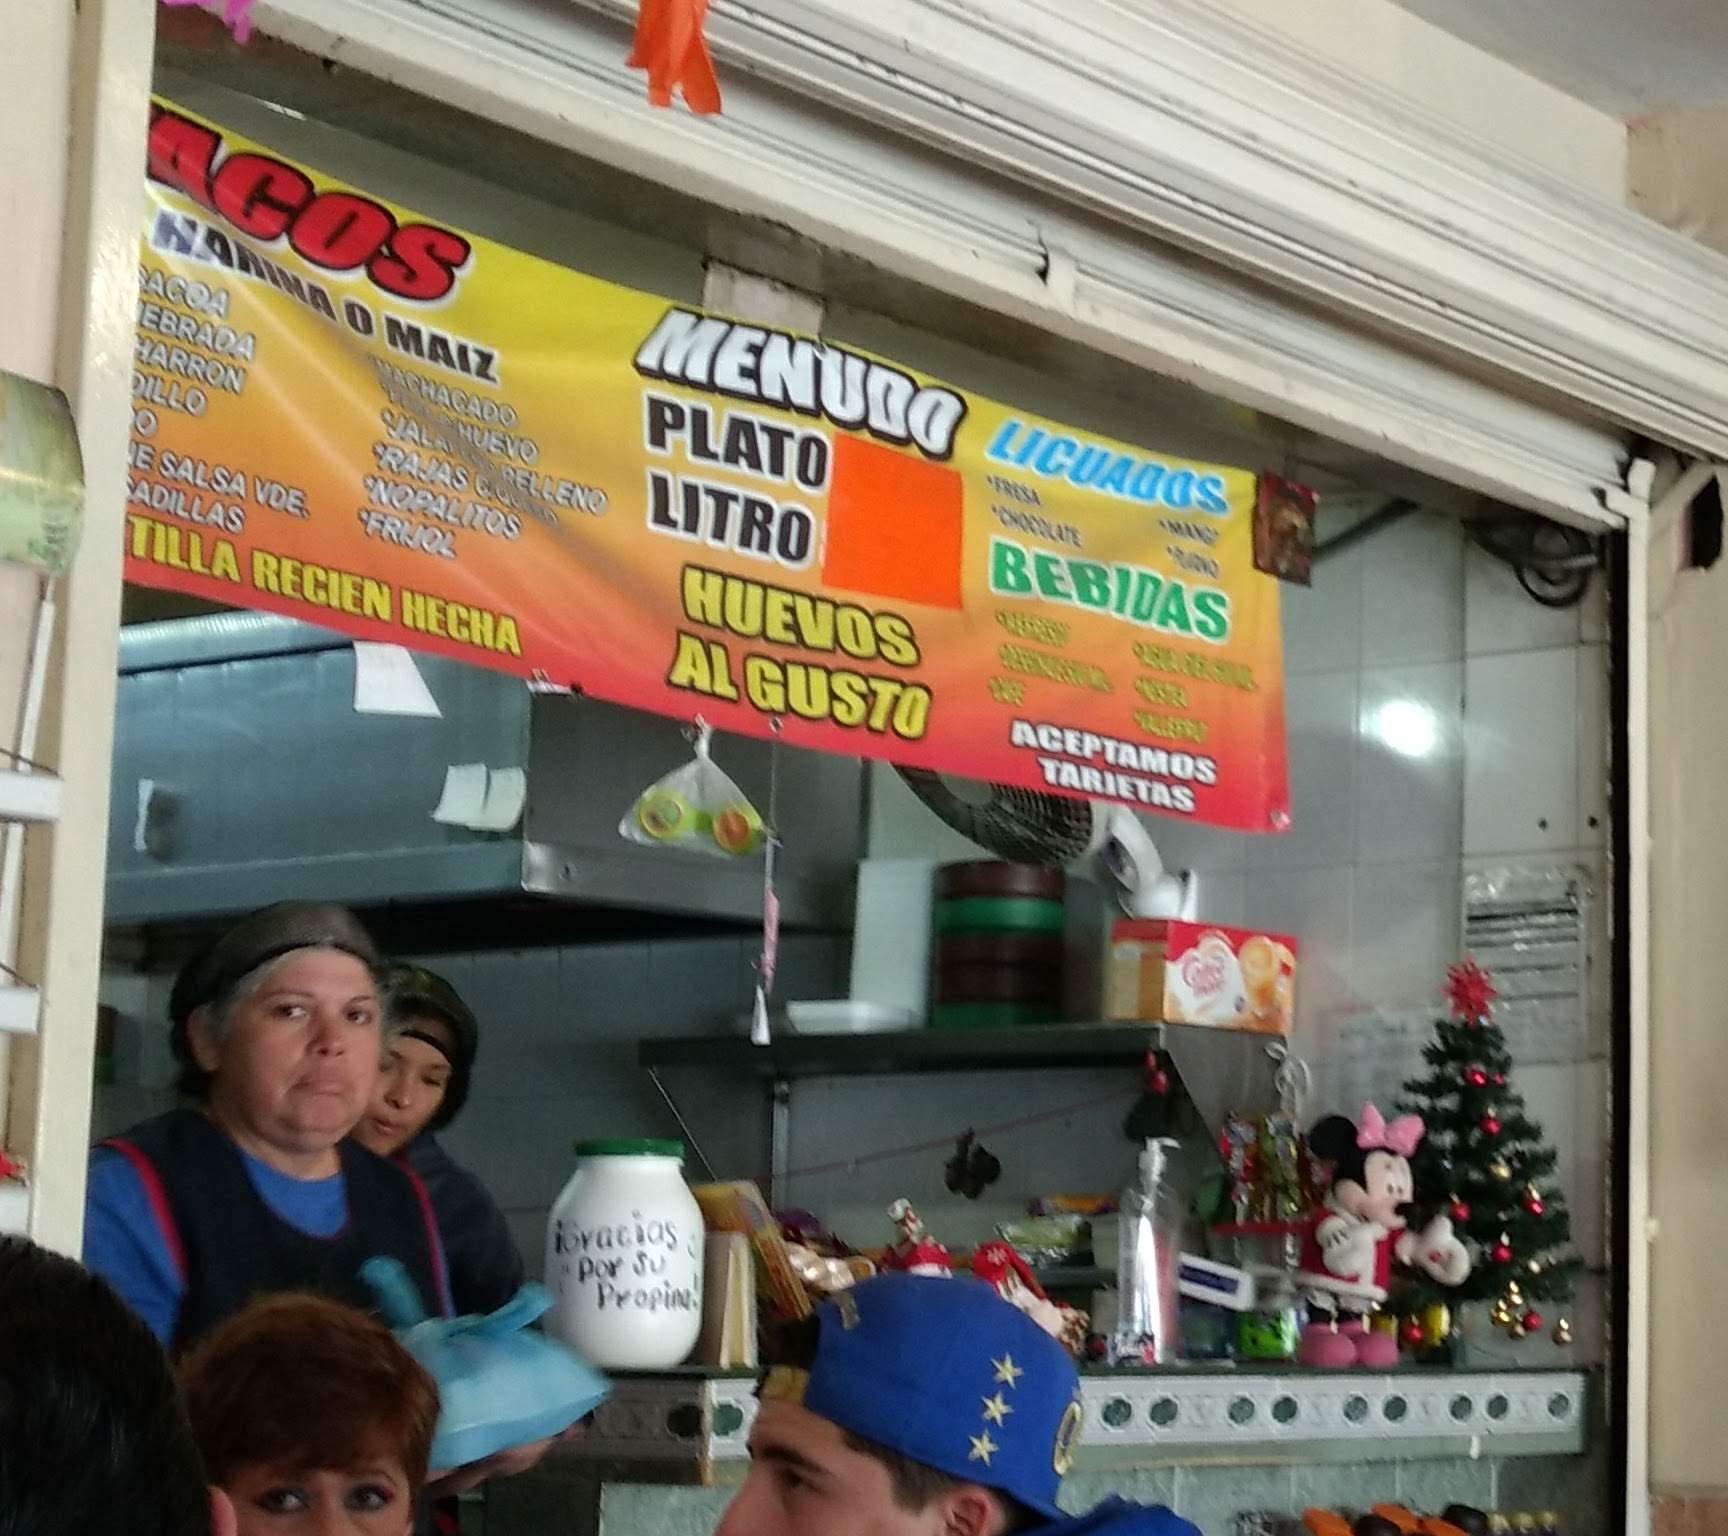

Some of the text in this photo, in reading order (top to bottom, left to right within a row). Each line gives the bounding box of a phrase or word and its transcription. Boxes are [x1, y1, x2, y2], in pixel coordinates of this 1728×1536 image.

[147, 101, 472, 301] ACOS
[344, 299, 375, 337] O
[385, 316, 499, 384] MAIZ
[633, 307, 969, 460] MENUDO
[160, 449, 247, 501] SALSA
[644, 395, 829, 488] PLATO
[986, 418, 1232, 520] LICUADOS
[648, 474, 812, 563] LITRO
[252, 547, 392, 624] RECIEN
[401, 587, 523, 658] HECHA
[680, 565, 922, 666] HUEVOS
[990, 538, 1231, 643] BEBIDAS
[668, 632, 739, 702] AL
[743, 654, 934, 742] GUSTO
[1009, 716, 1218, 785] ACEPTAMOS
[577, 1254, 624, 1283] por
